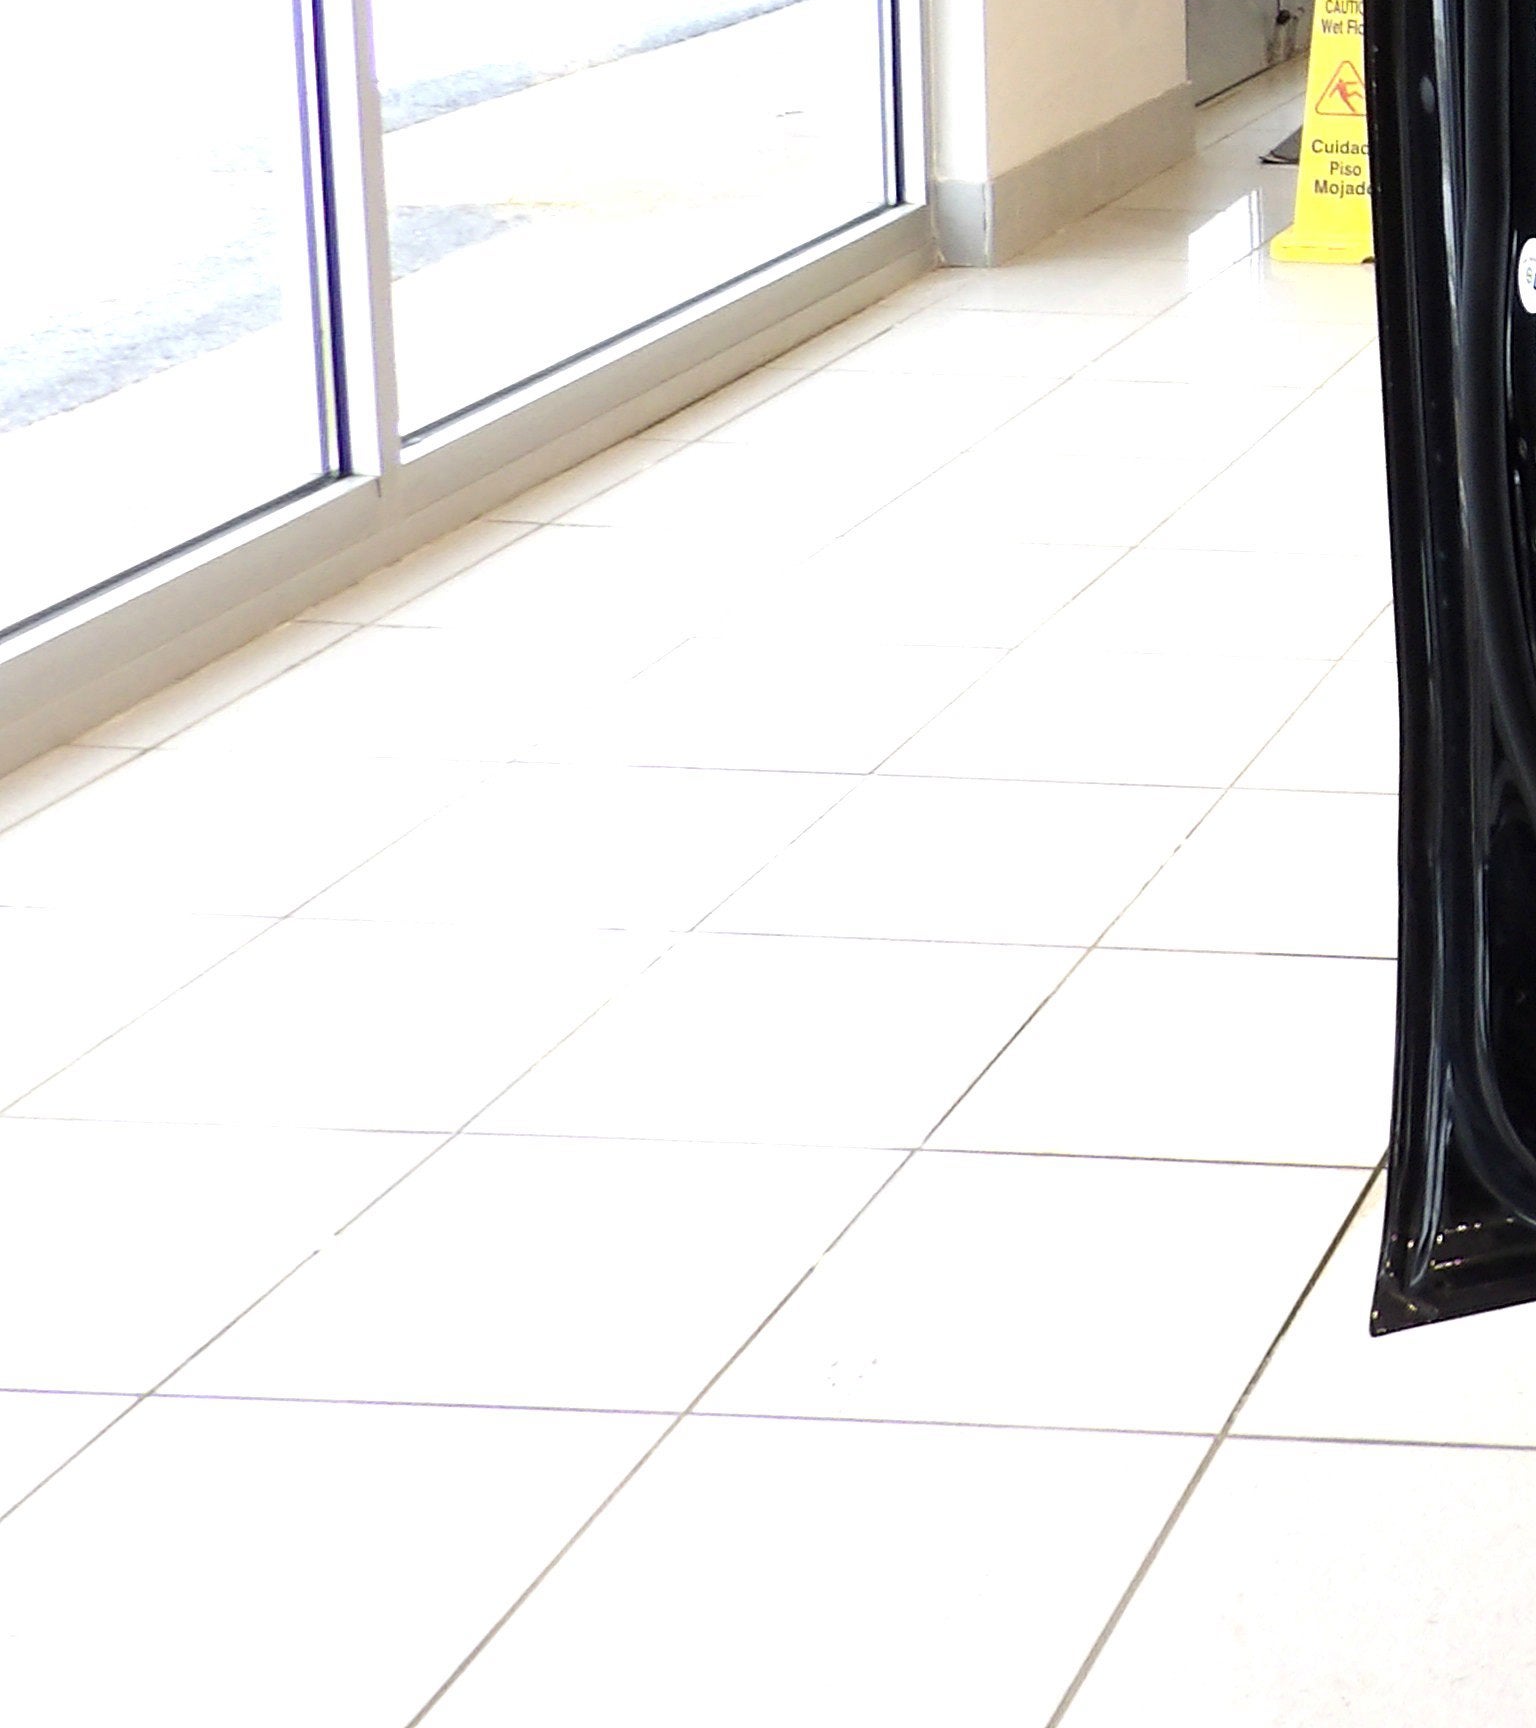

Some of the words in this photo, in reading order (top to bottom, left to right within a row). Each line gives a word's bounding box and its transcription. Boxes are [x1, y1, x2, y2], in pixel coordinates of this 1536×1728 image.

[1321, 18, 1343, 34] Wet
[1347, 19, 1364, 36] Flo
[1330, 160, 1362, 177] Piso
